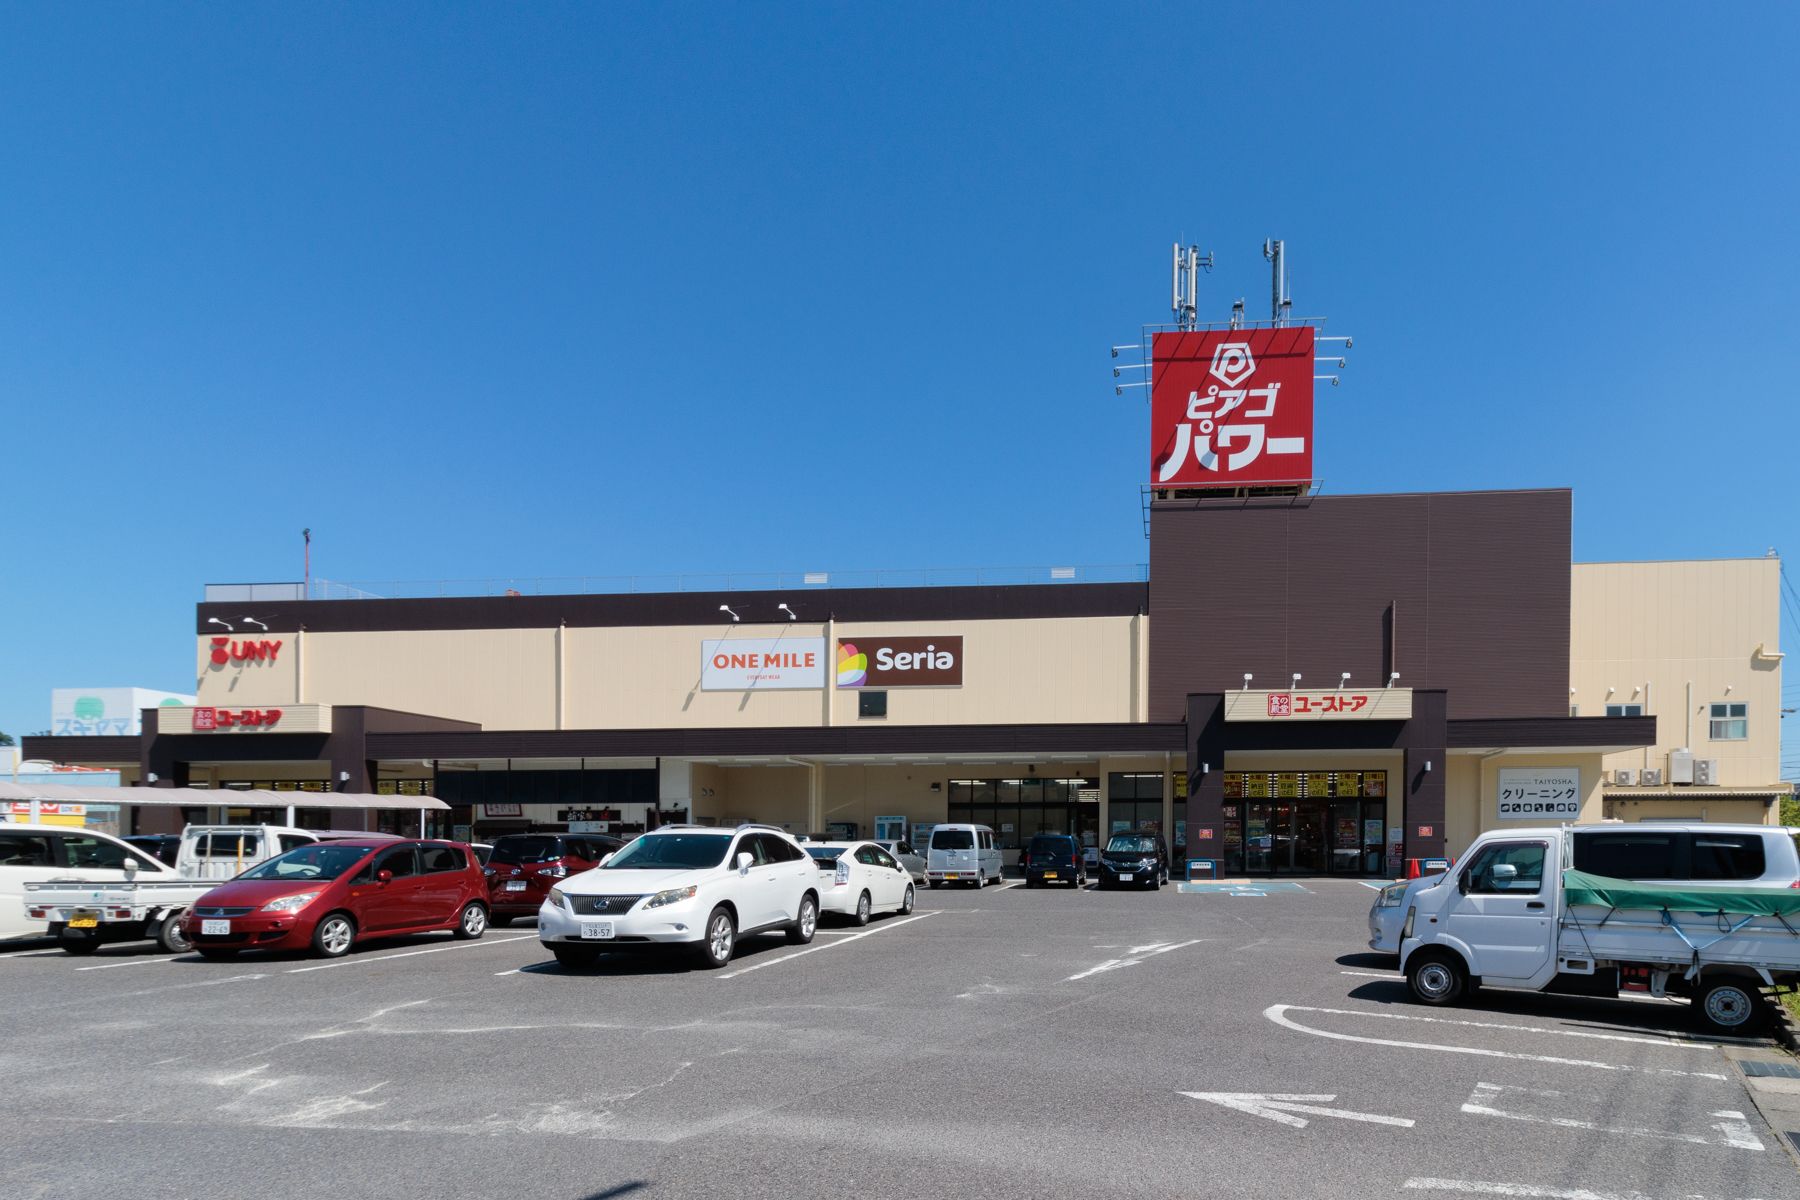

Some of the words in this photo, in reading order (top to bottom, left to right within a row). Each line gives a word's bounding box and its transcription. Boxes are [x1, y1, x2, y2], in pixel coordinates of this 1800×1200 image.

[1186, 382, 1281, 420] ピアゴ
[1159, 419, 1305, 482] パワー
[230, 640, 283, 661] UNY
[876, 644, 954, 671] Seria
[713, 653, 759, 670] ONE
[763, 652, 815, 668] MILE
[1294, 696, 1368, 712] ユーストア
[216, 709, 283, 727] ユーストア
[1502, 787, 1576, 799] クリーニング
[588, 928, 611, 937] 38-57
